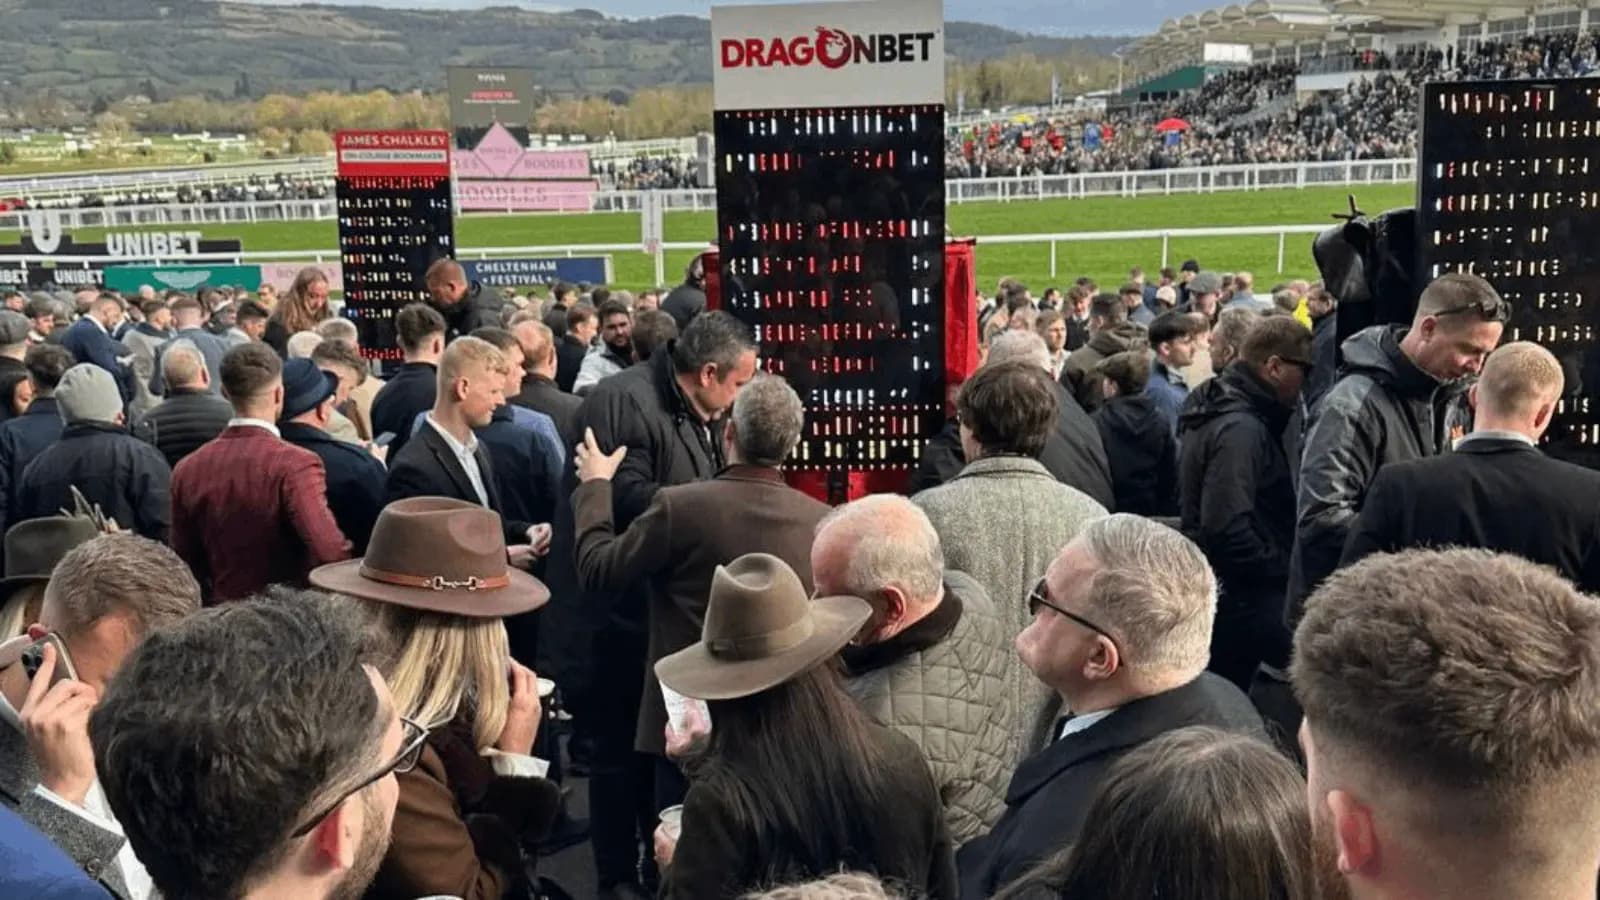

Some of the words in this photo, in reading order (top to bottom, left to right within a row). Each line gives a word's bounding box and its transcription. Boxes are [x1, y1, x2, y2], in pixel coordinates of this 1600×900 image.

[720, 26, 934, 69] DRAGONBET
[341, 136, 380, 146] JAMES
[381, 135, 447, 146] CHALKLEY
[105, 231, 202, 256] UNIBET
[475, 260, 557, 273] CHELTENHAM
[54, 269, 104, 284] UNIBET
[490, 274, 545, 285] FESTIVAL
